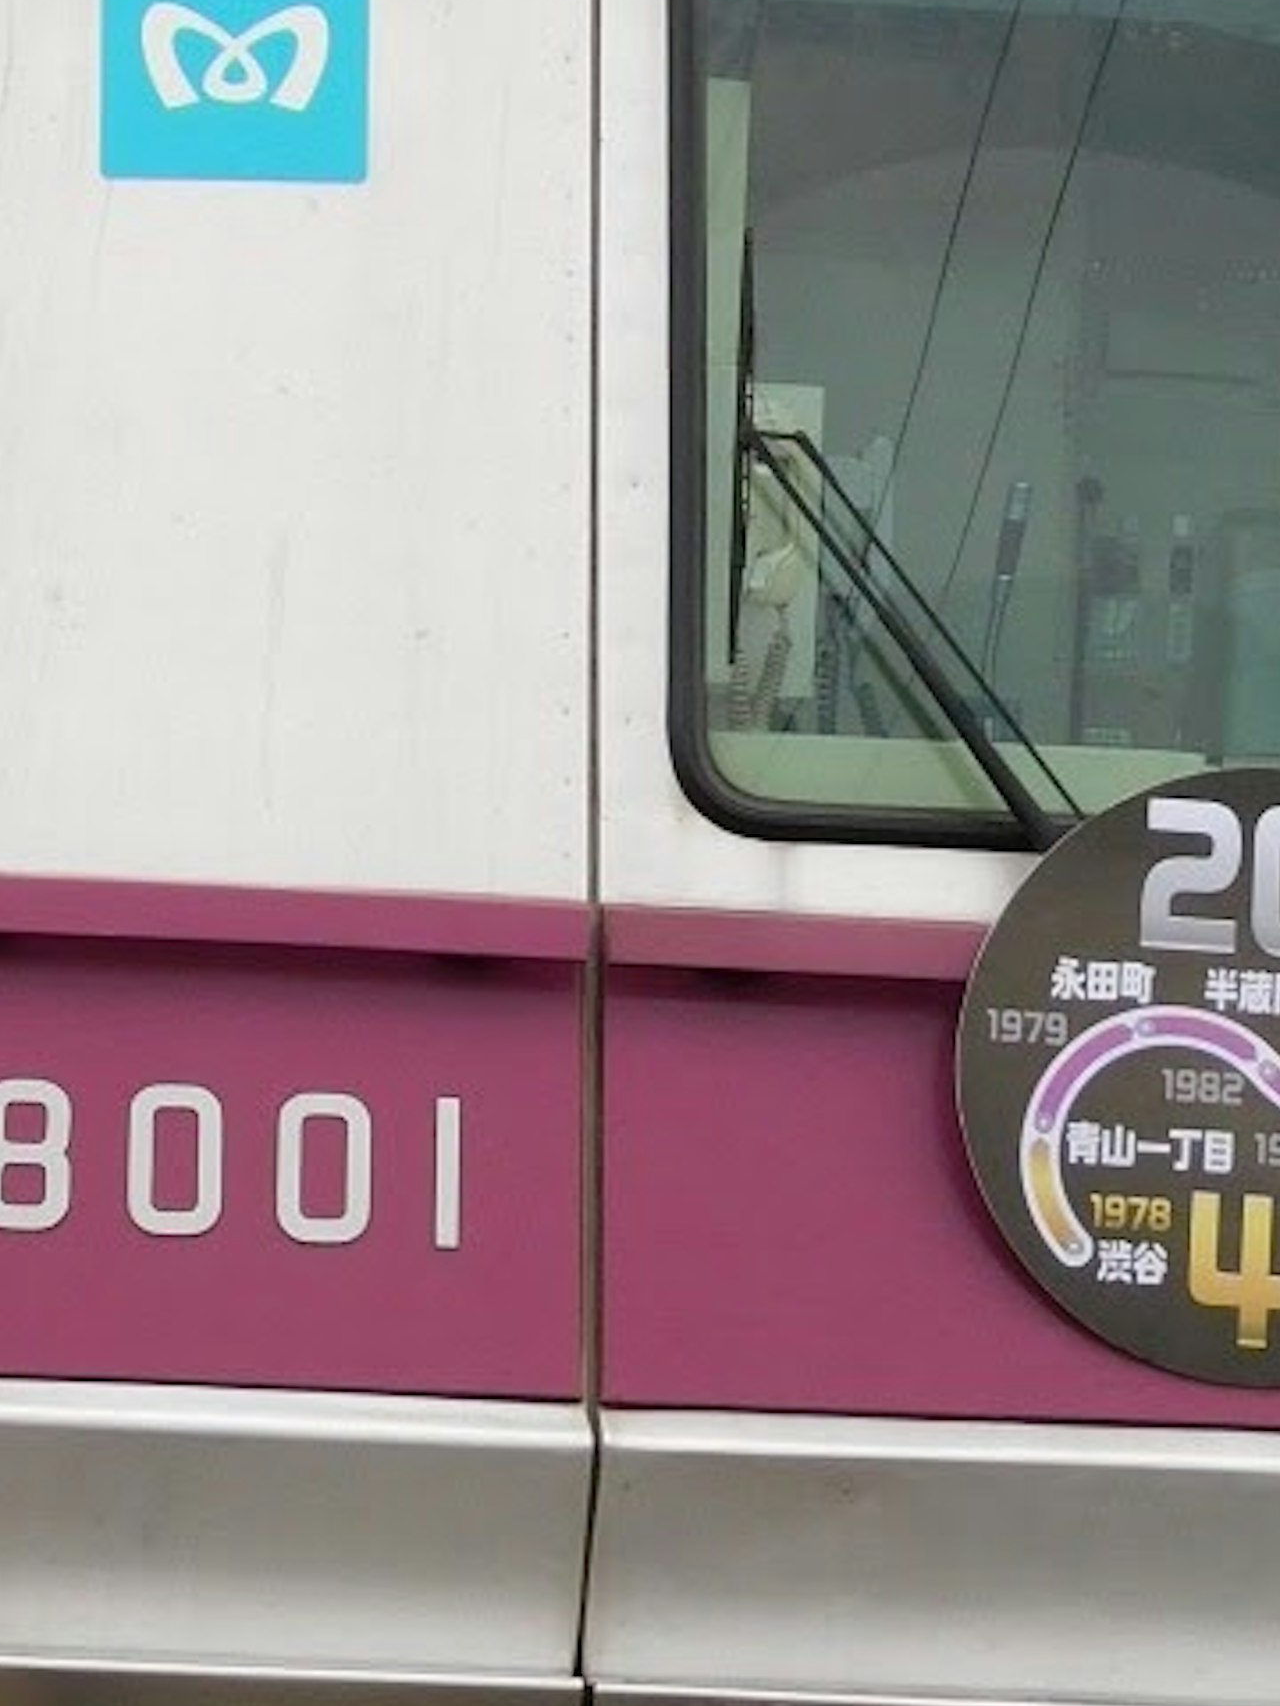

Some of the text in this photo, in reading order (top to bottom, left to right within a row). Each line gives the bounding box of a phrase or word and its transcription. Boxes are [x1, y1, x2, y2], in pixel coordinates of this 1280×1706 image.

[1050, 957, 1157, 1004] 永田町
[986, 1007, 1069, 1046] 1979
[1161, 1068, 1244, 1106] 1982
[1066, 1121, 1235, 1173] 青山一丁目
[1088, 1193, 1173, 1230] 1978
[1096, 1238, 1168, 1284] 渋谷
